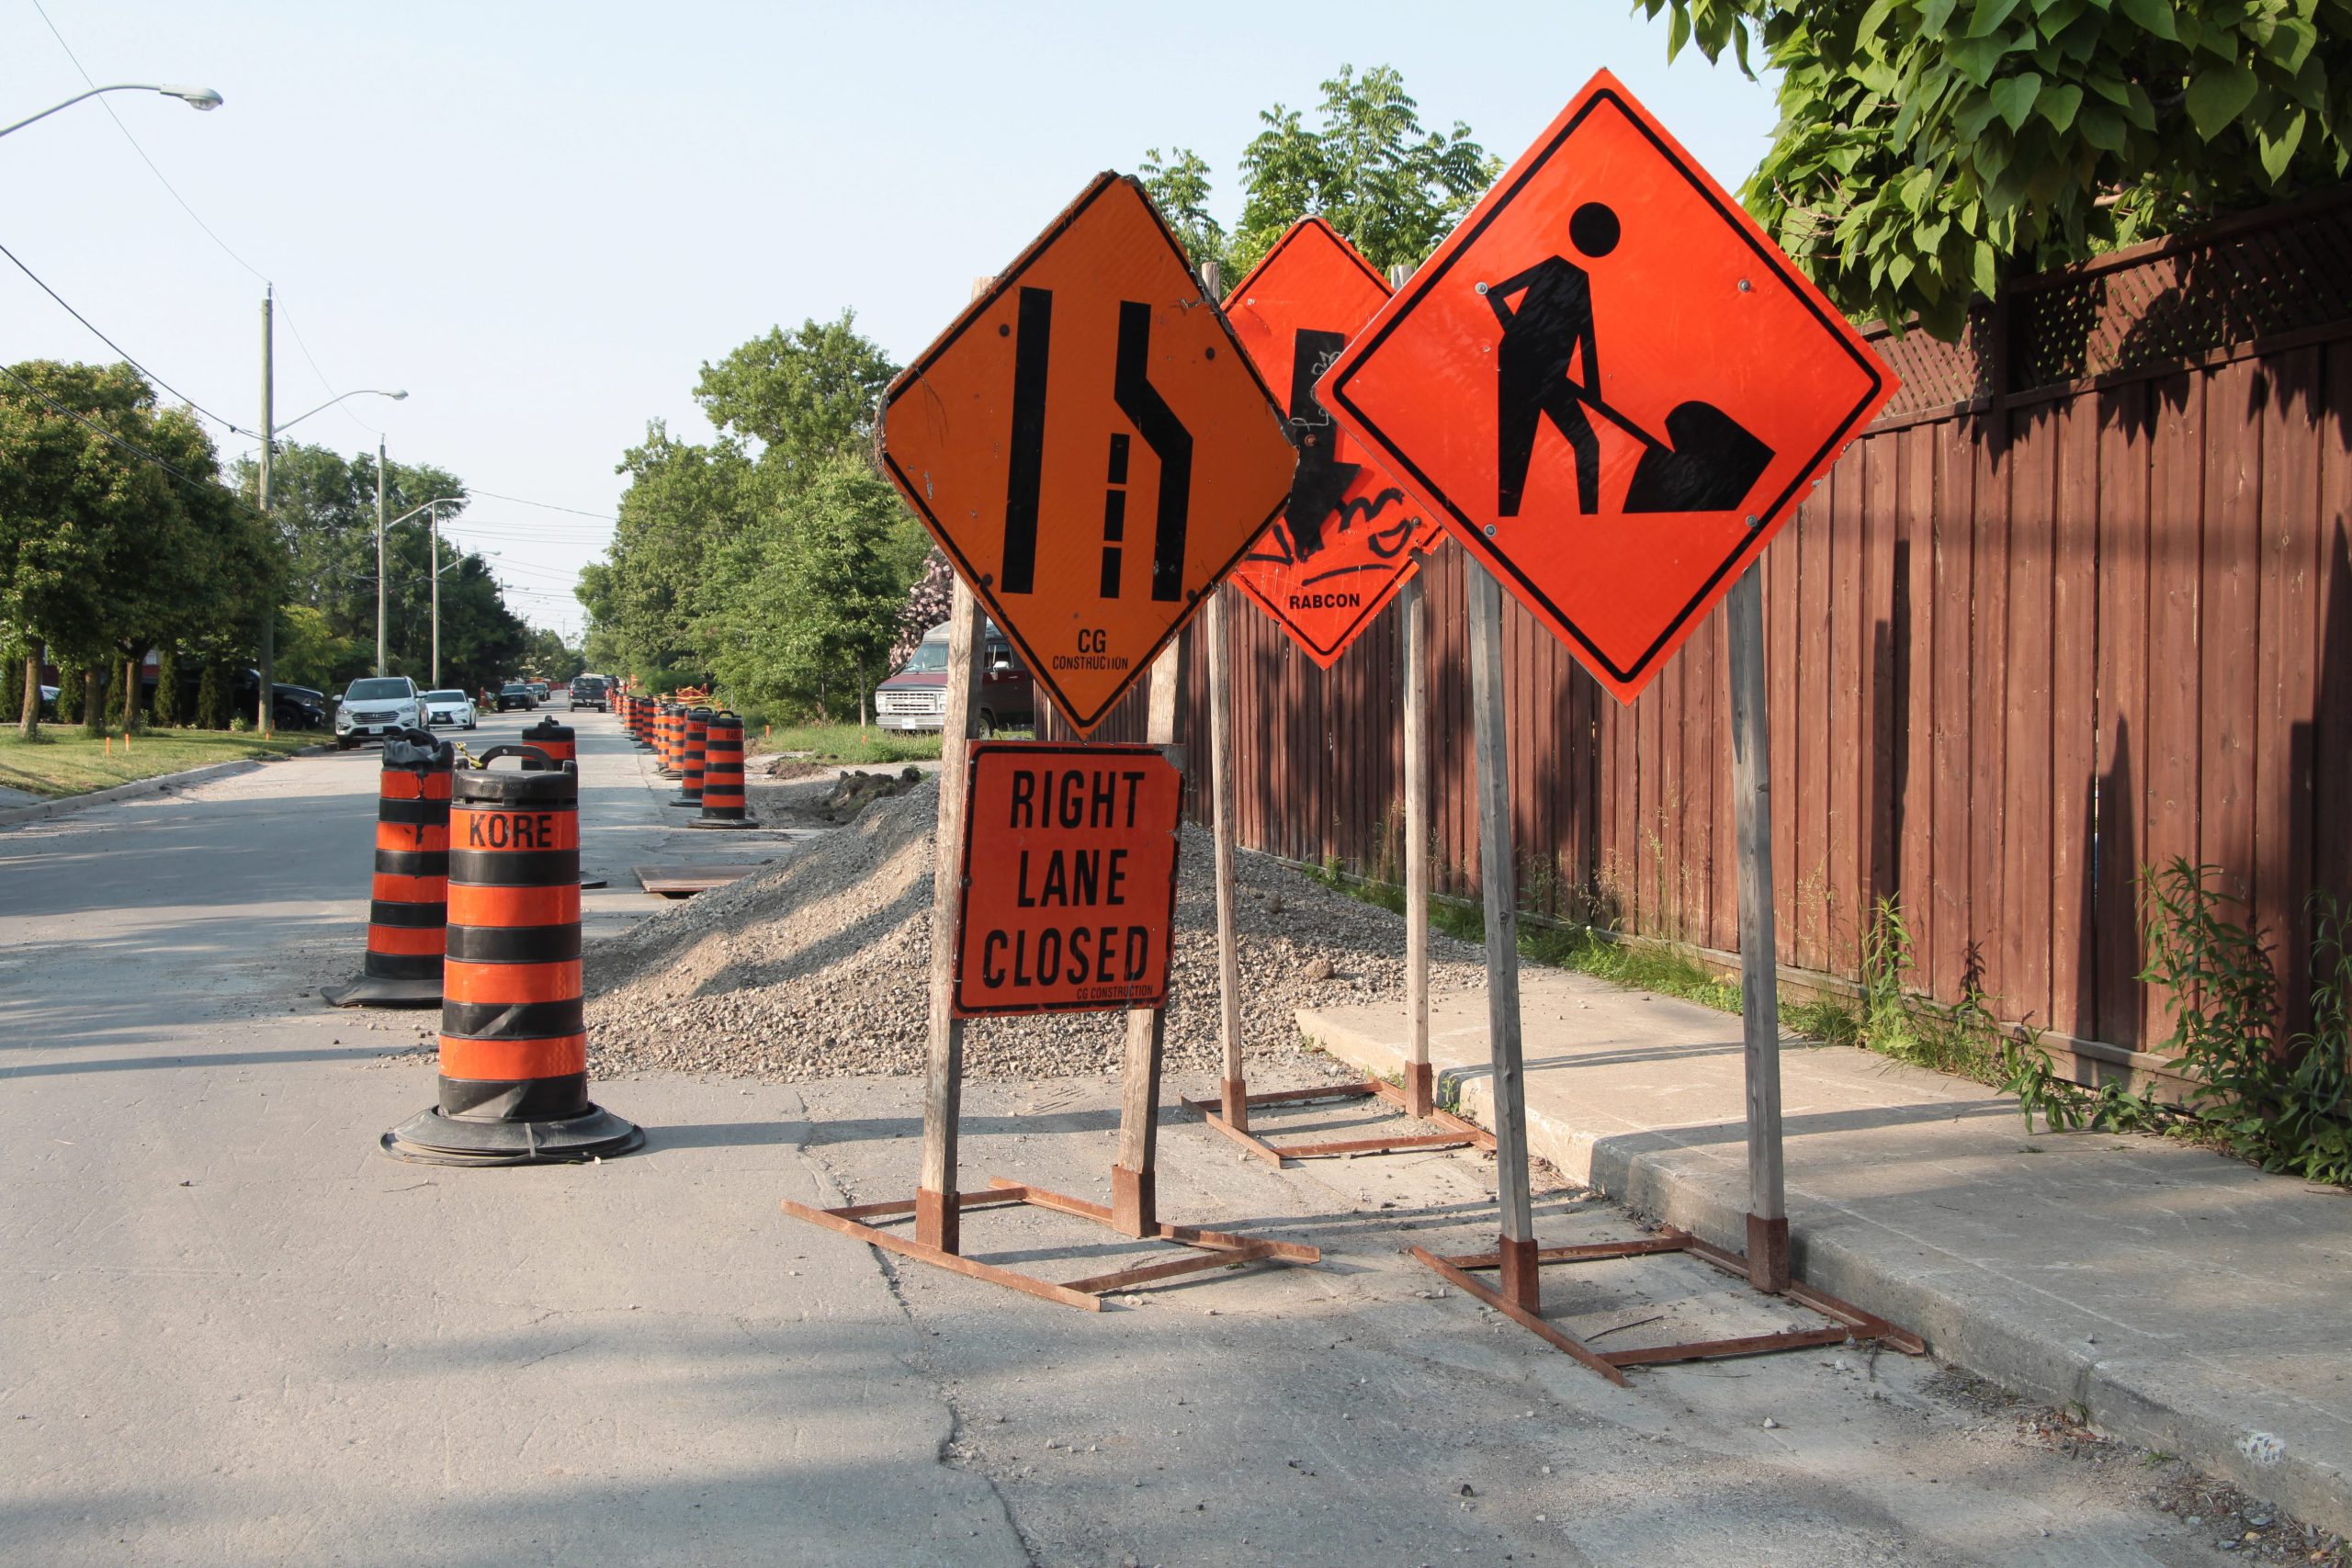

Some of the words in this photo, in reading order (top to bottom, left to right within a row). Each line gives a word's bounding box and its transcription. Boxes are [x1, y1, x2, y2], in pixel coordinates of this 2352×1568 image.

[1289, 593, 1360, 609] RABCON
[1078, 628, 1106, 653] CG
[1052, 655, 1128, 670] CONSTRUCTION
[1010, 770, 1146, 829] RIGHT
[469, 813, 552, 848] KORE
[1017, 849, 1128, 908] LANE
[982, 925, 1148, 989] CLOSED
[1077, 987, 1089, 1000] CG
[1091, 984, 1153, 999] CONSTRUCTION
